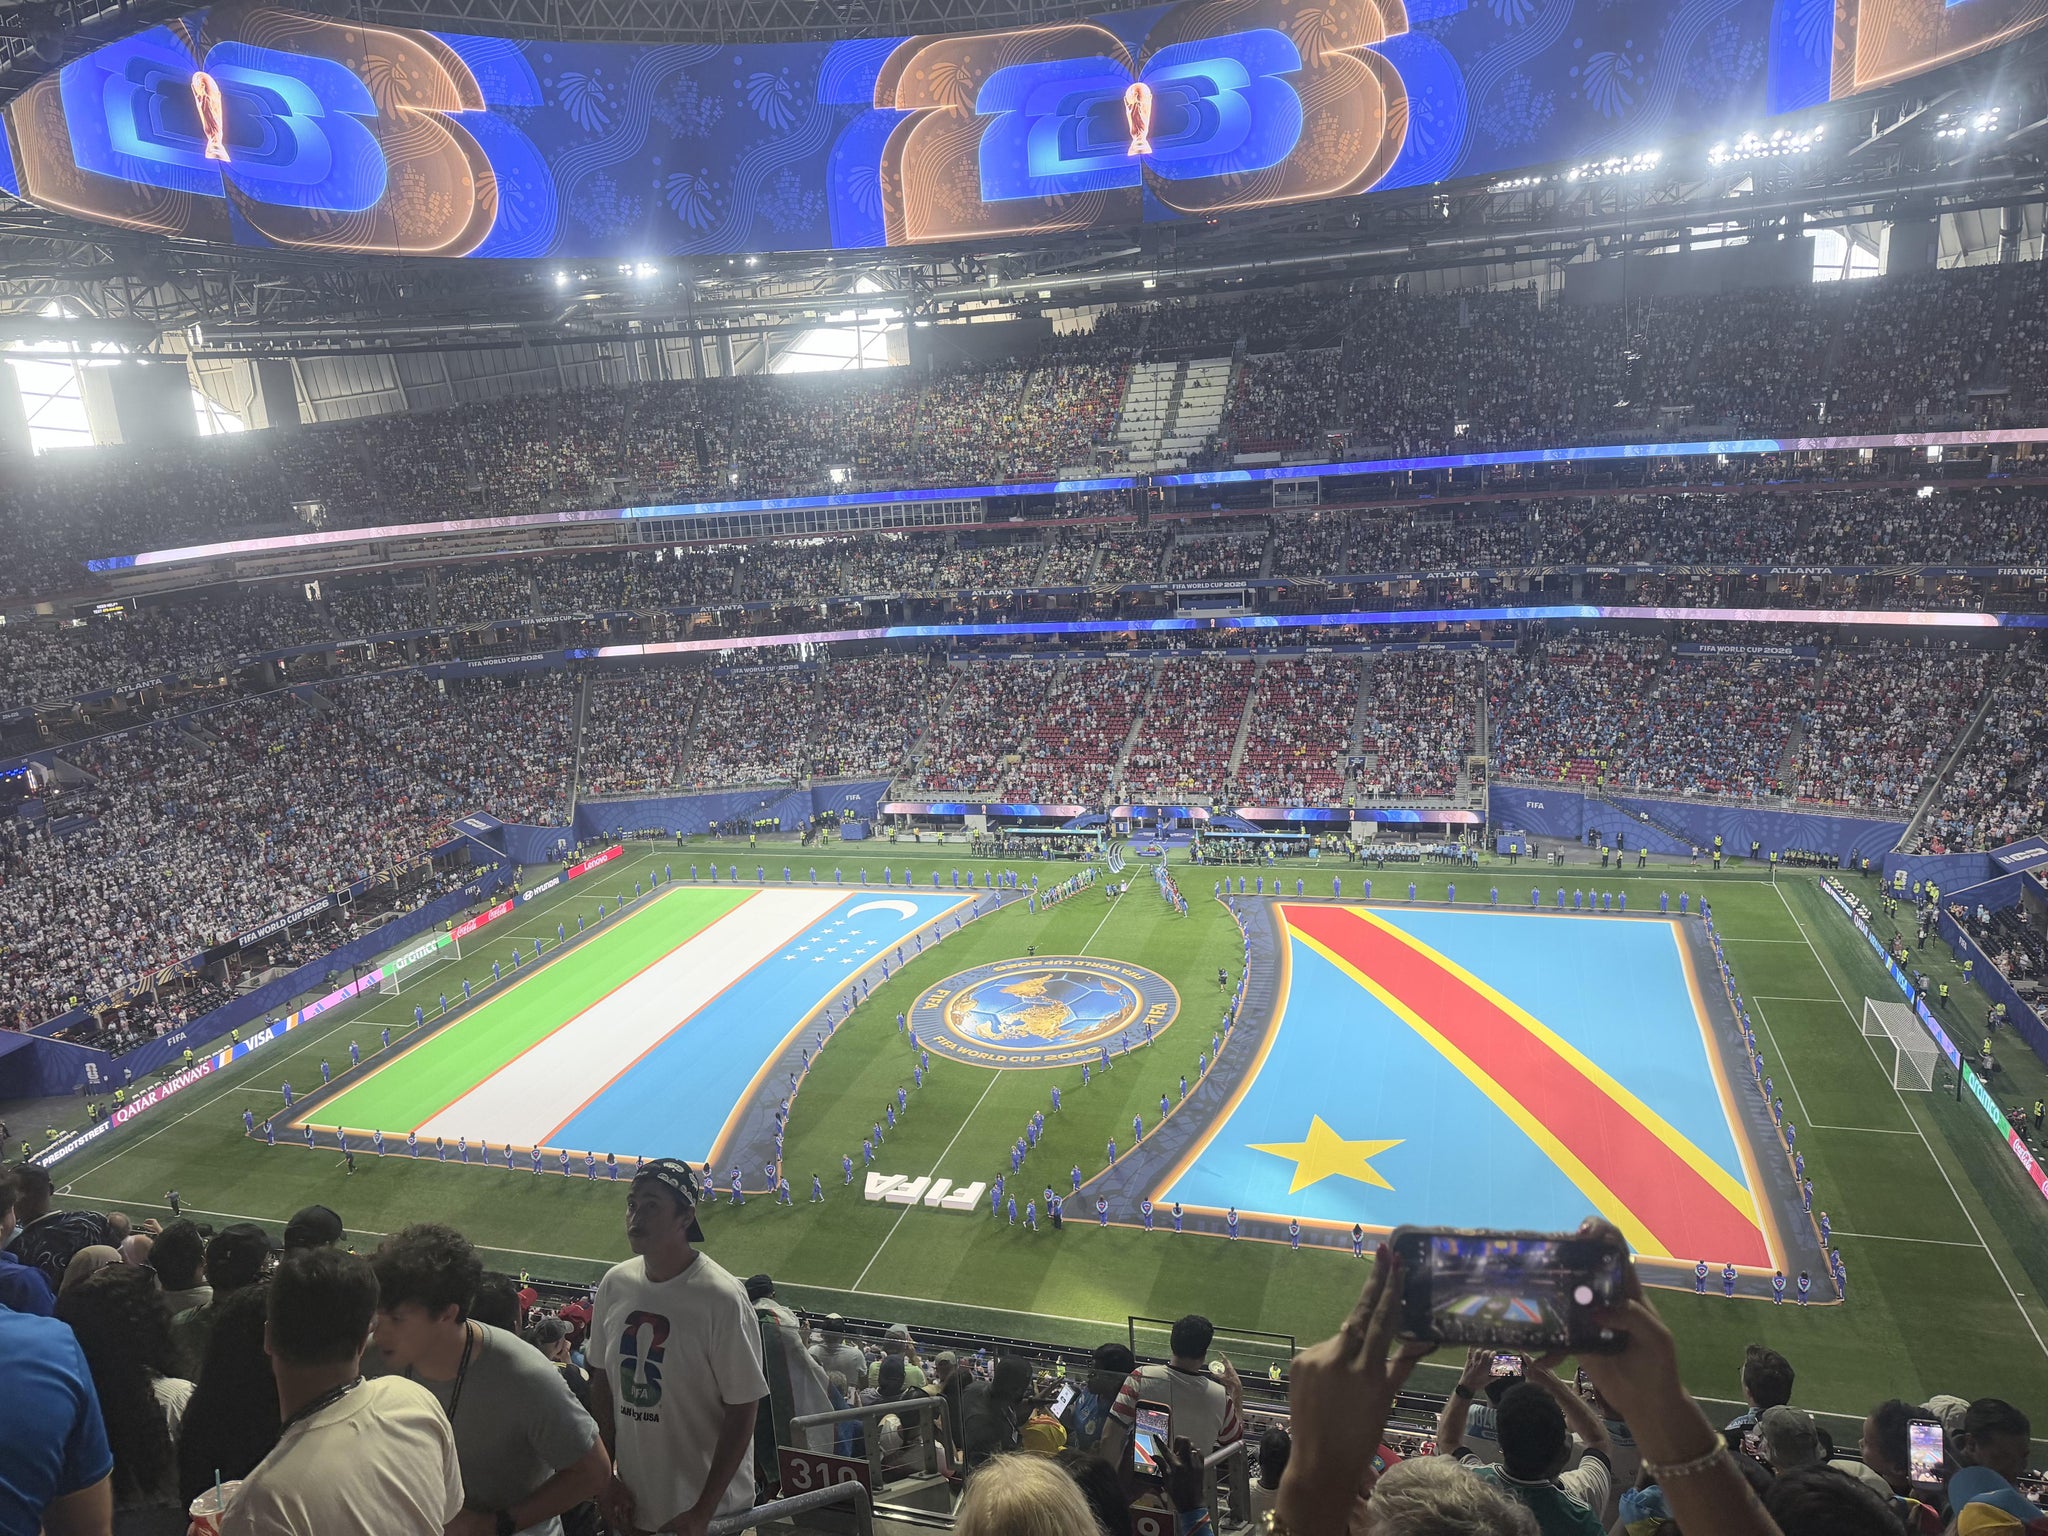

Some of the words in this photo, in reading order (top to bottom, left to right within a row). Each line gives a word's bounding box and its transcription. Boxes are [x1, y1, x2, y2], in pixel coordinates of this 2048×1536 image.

[700, 604, 744, 612] ATLANTA
[115, 678, 163, 694] ATLANTA
[1526, 801, 1545, 810] FIFA
[583, 854, 608, 872] Lenovo
[533, 876, 560, 896] HYUNDAI
[238, 932, 258, 946] FIFA
[257, 919, 287, 937] WORLD
[287, 912, 302, 924] CUP
[303, 899, 330, 918] 2026
[993, 960, 1043, 972] 2026
[1074, 960, 1120, 972] WORLD
[1121, 968, 1146, 980] FIFA
[922, 989, 951, 1010] FIFA
[1142, 1002, 1168, 1025] FIFA
[166, 1032, 187, 1047] FIFA
[245, 1028, 274, 1051] VISA
[933, 1035, 956, 1050] FIFA
[957, 1046, 1008, 1062] WORLD
[1044, 1046, 1102, 1061] 2026
[116, 1092, 157, 1122] QATAR
[161, 1062, 210, 1100] AIRWAYS
[1968, 1070, 2000, 1125] aramco
[42, 1120, 110, 1167] PREDICTSTREET
[864, 1171, 986, 1210] FIFA
[643, 1412, 660, 1423] USA
